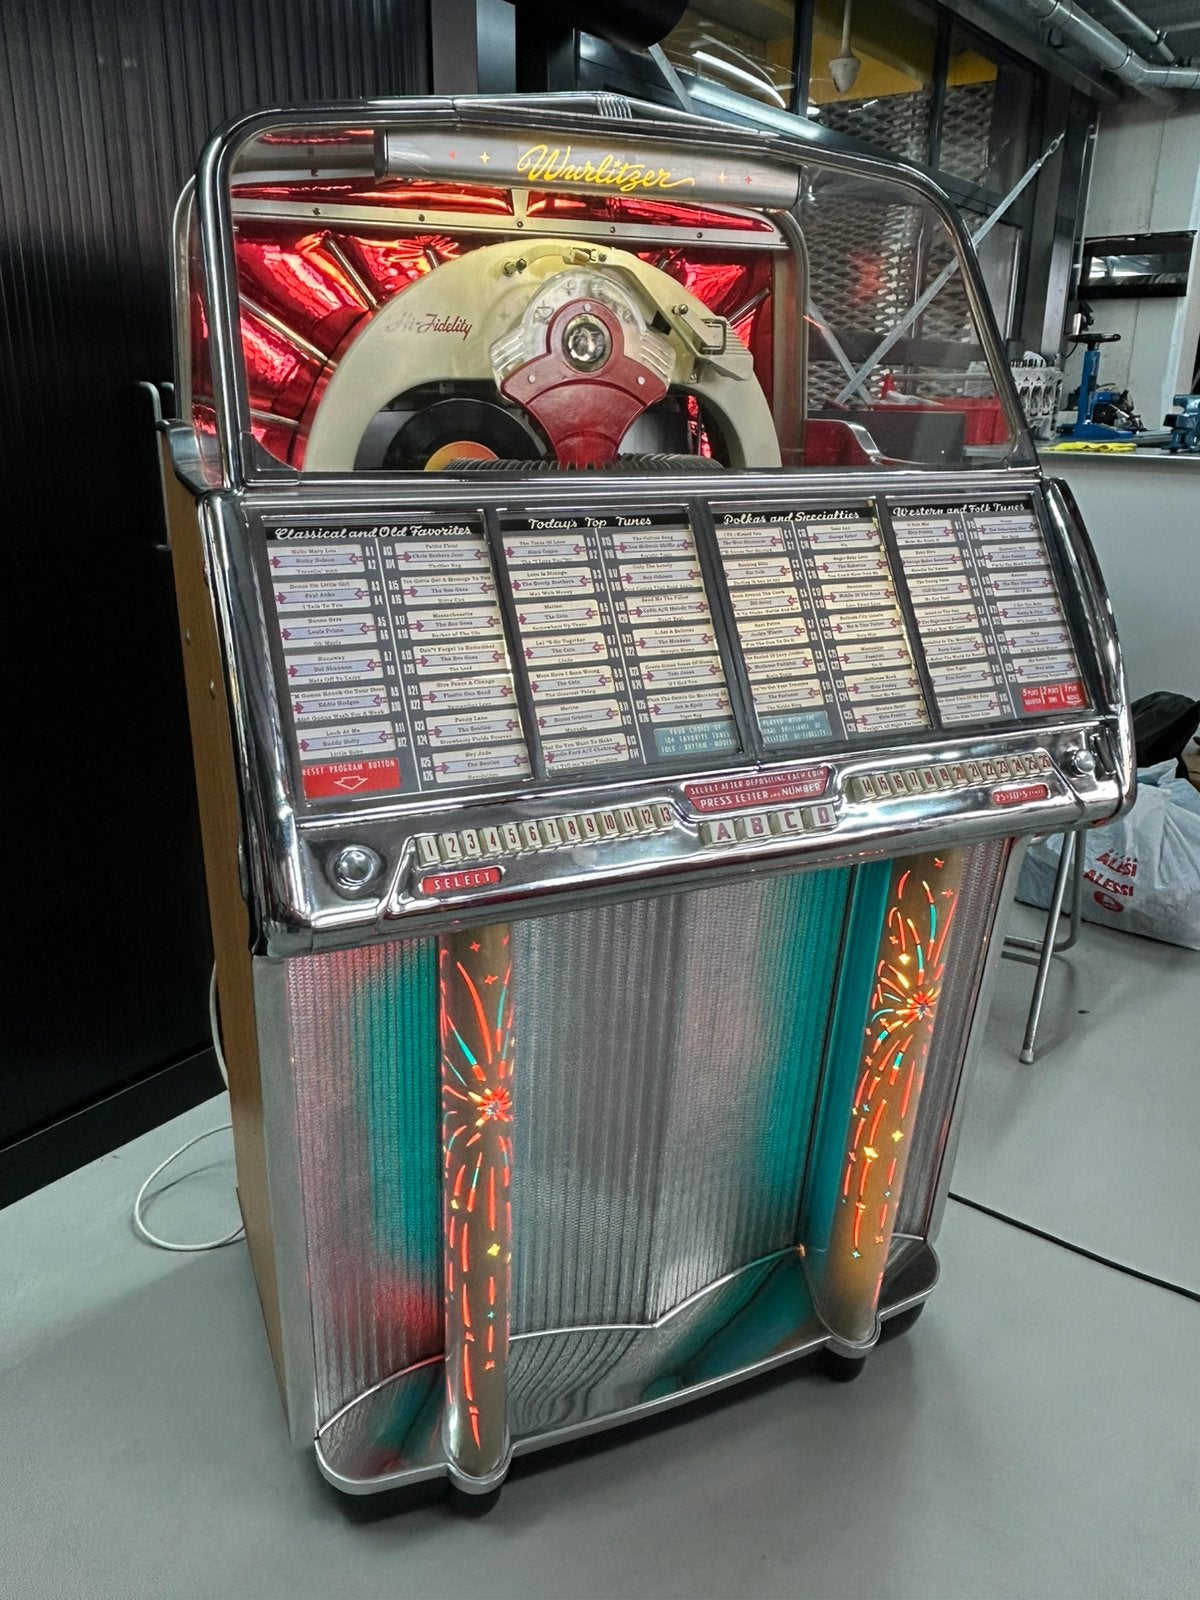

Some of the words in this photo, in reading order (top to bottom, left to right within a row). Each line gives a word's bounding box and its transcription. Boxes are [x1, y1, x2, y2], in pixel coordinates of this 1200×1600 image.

[517, 144, 695, 192] Wurlitzer
[386, 311, 473, 341] Hi-Fidelity
[724, 513, 766, 525] Polkas
[770, 512, 793, 522] and
[795, 510, 860, 521] Specialties
[893, 506, 943, 516] Western
[947, 504, 967, 514] and
[968, 503, 990, 513] Folk
[993, 503, 1025, 512] Tunes
[528, 518, 577, 530] Today's
[585, 517, 607, 528] Top
[616, 516, 652, 526] Tunes
[275, 528, 347, 540] Classical
[349, 527, 377, 538] and
[379, 526, 406, 537] Old
[410, 525, 472, 536] Favorites
[329, 763, 363, 773] PROGRAM
[368, 759, 395, 770] BUTTON
[690, 784, 719, 795] SELECT
[721, 780, 743, 791] AFTER
[787, 771, 806, 781] EACH
[862, 778, 873, 793] 14
[877, 776, 886, 790] 15
[893, 774, 903, 788] 16
[908, 772, 918, 786] 17
[939, 768, 949, 781] 19
[969, 764, 979, 777] 21
[983, 762, 994, 775] 22
[997, 760, 1008, 773] 23
[700, 796, 732, 809] PRESS
[735, 789, 768, 803] LETTER
[781, 782, 821, 796] NUMBER
[784, 811, 797, 829] C
[817, 806, 830, 824] D
[427, 841, 433, 856] 1
[448, 838, 457, 853] 2
[466, 834, 476, 849] 3
[490, 831, 497, 847] 4
[508, 829, 516, 844] 5
[529, 826, 537, 841] 6
[548, 823, 557, 839] 7
[569, 821, 577, 836] 8
[586, 817, 596, 832] 9
[603, 815, 616, 830] 10
[623, 812, 635, 827] 11
[641, 809, 653, 824] 12
[660, 806, 672, 822] 13
[717, 822, 732, 840] A
[751, 817, 764, 835] B
[434, 872, 491, 890] SELECT
[1083, 869, 1134, 897] ALESSI
